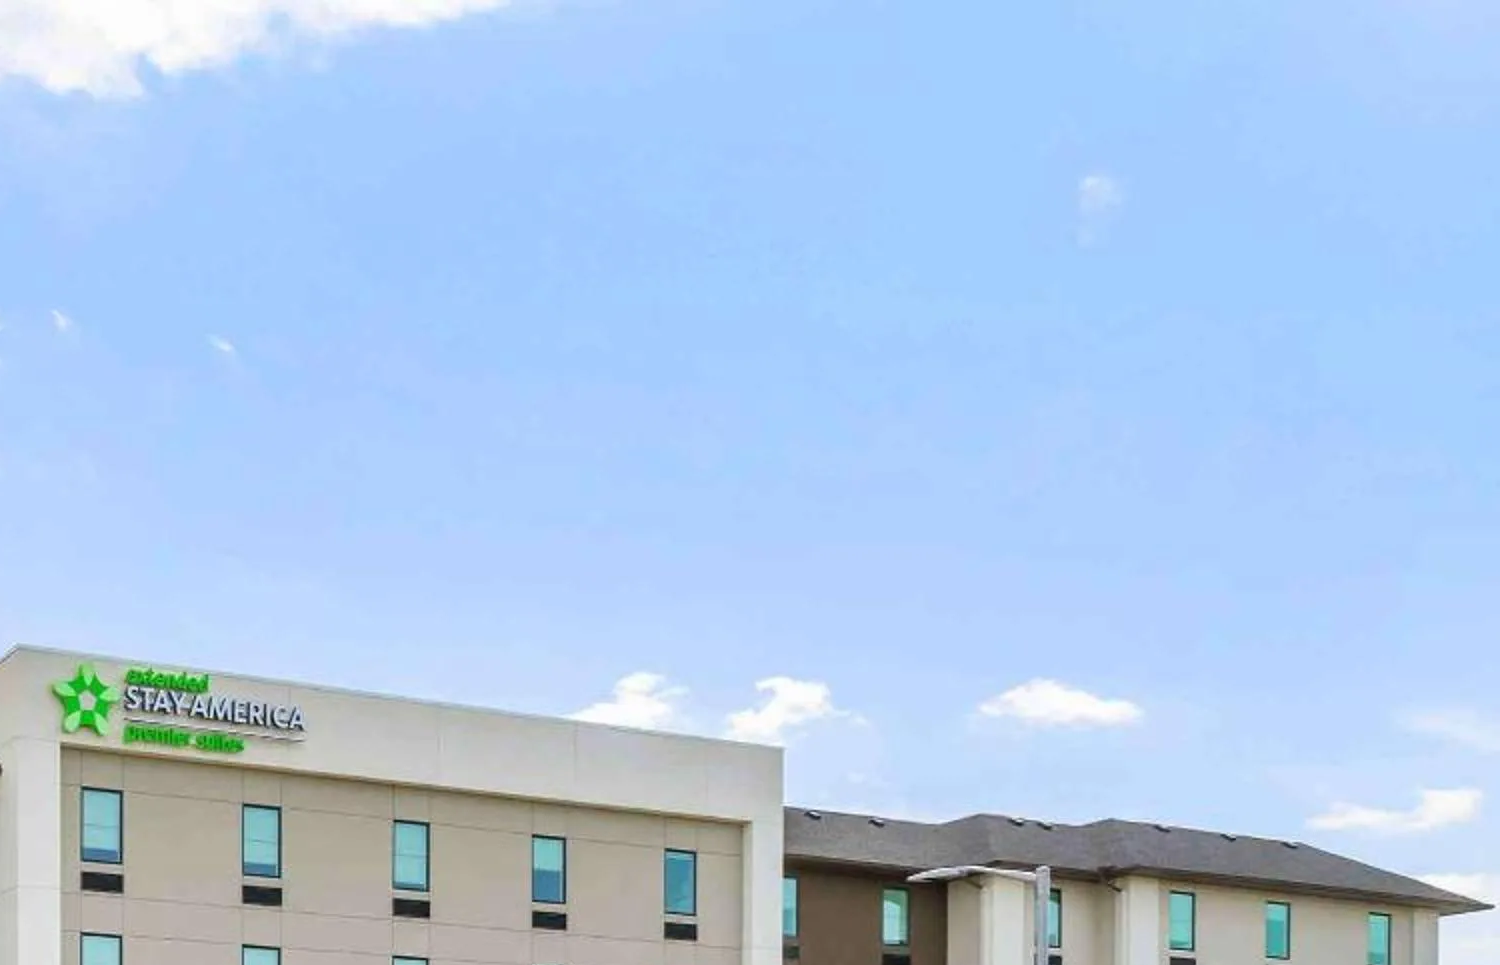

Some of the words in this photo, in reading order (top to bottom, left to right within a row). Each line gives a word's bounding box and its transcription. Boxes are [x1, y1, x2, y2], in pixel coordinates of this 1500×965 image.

[125, 669, 209, 693] extended
[124, 725, 191, 747] premier
[195, 732, 245, 753] suites
